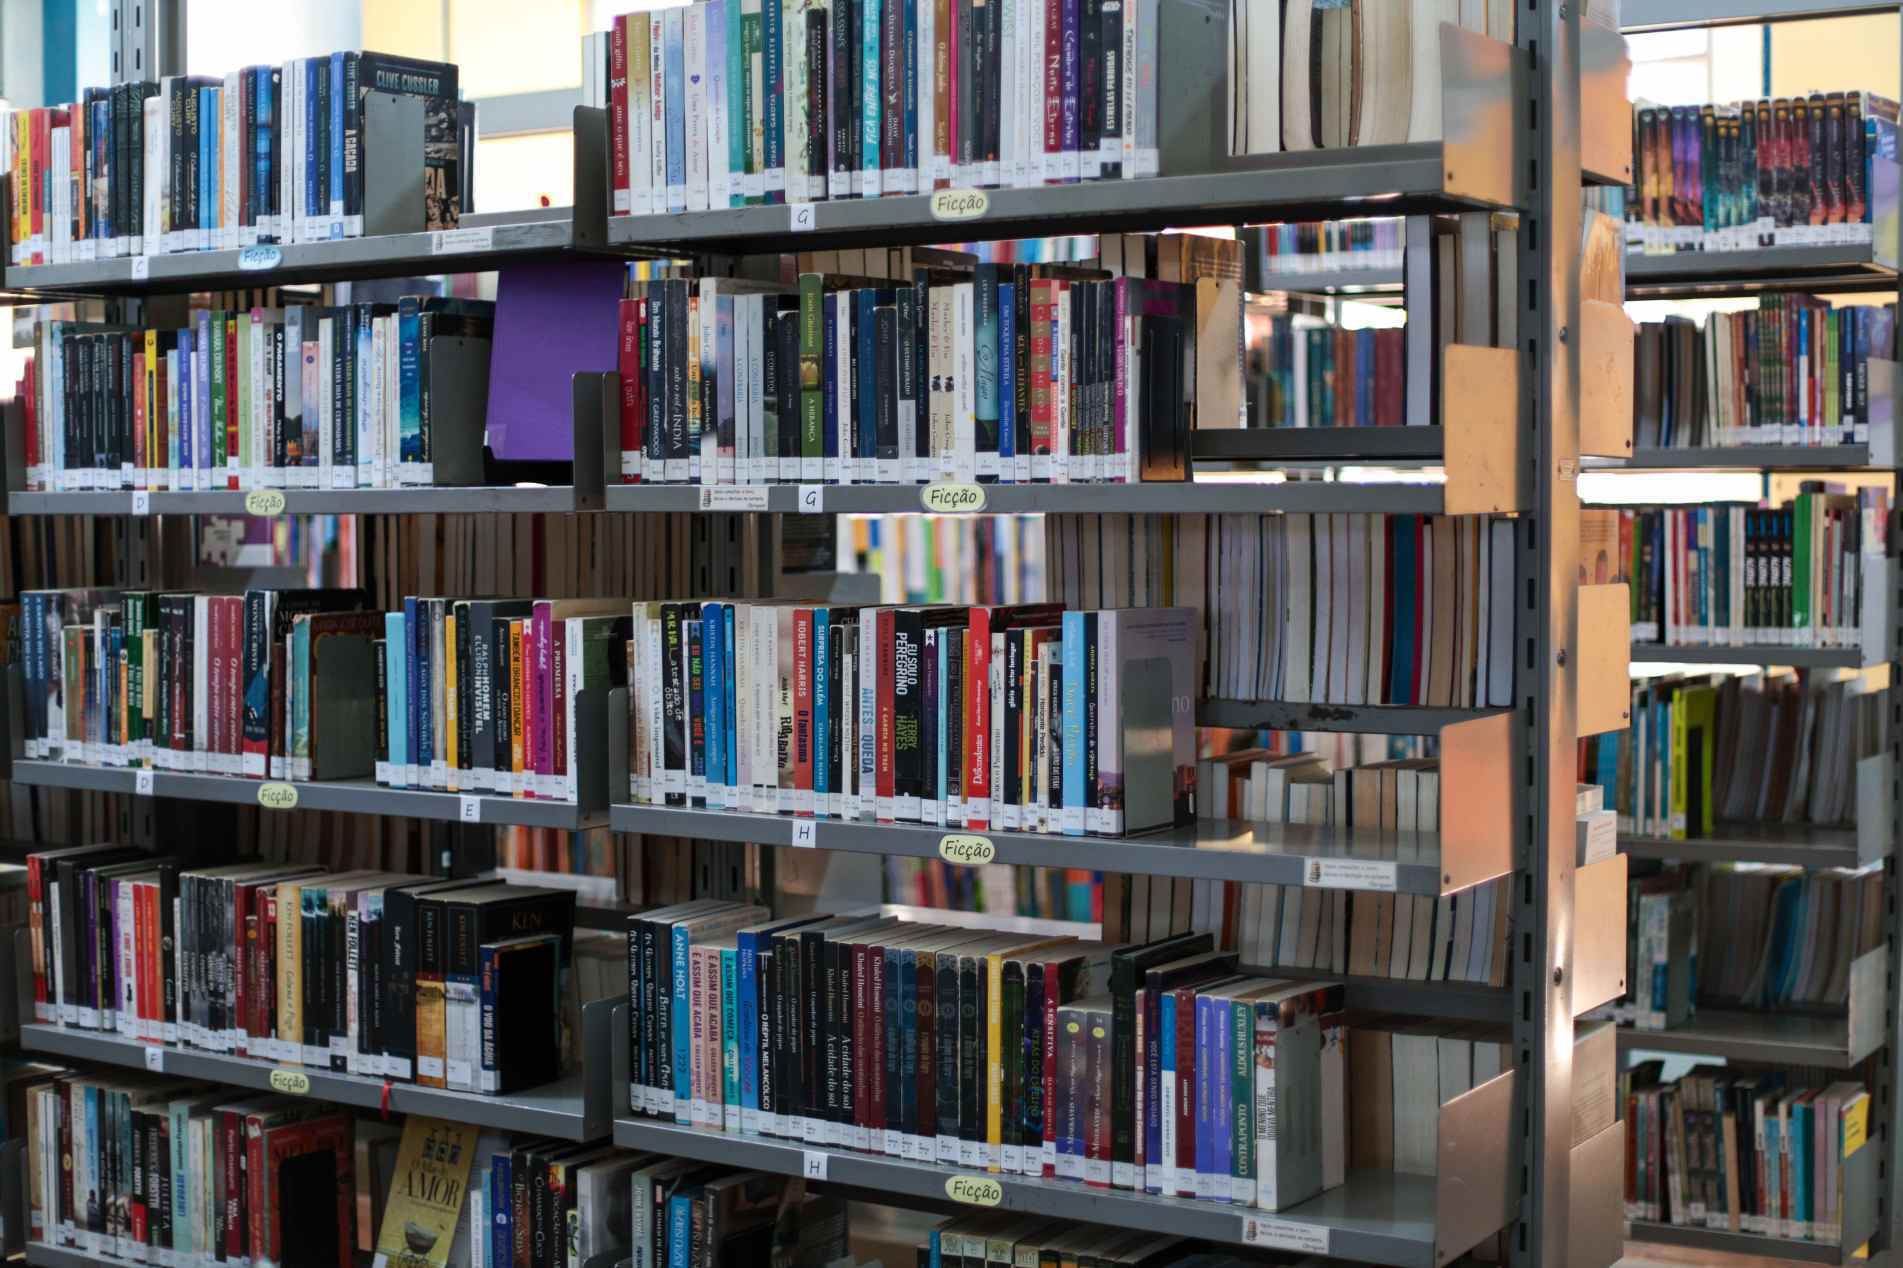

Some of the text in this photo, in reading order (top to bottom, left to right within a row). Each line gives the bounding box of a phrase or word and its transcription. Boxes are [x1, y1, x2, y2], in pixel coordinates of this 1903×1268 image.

[190, 88, 198, 135] AUGUSTO
[343, 137, 357, 173] CAÇADA
[797, 209, 809, 224] G
[936, 193, 985, 214] Ficção
[276, 332, 283, 340] O
[137, 497, 145, 509] D
[249, 493, 283, 514] Ficção
[805, 491, 816, 507] G
[929, 489, 978, 509] Ficção
[797, 620, 807, 697] ROBERT HARRIS
[816, 624, 826, 706] SURPRESA DO ALÉM
[894, 632, 908, 696] PEREGRINO
[907, 643, 919, 685] EU SOU O
[553, 650, 562, 699] PROMESSA
[474, 676, 483, 735] INVISÍVEL
[482, 676, 490, 721] HOMEM
[860, 687, 875, 774] ANTES QUEDA
[895, 715, 918, 751] TERRY HAYES
[261, 786, 295, 805] Ficção
[465, 804, 474, 816] E
[799, 826, 810, 841] H
[944, 839, 991, 861] Ficção
[347, 935, 358, 971] FOLLETT
[675, 933, 686, 1000] ANNE HOLT
[692, 960, 702, 989] ASSIM
[708, 962, 718, 991] ASSIM
[692, 990, 702, 1009] QUE
[708, 993, 718, 1011] QUE
[692, 1009, 702, 1039] ACABA
[708, 1013, 718, 1042] ACABA
[762, 1021, 770, 1050] RÉPTIL
[1237, 1007, 1247, 1078] ALDOUS HUXLEY
[273, 1075, 306, 1091] Ficção
[762, 1051, 771, 1109] MELANCÓLICO
[827, 1034, 837, 1107] A cidade do sol
[842, 1035, 852, 1109] A cidade do sol
[1237, 1104, 1248, 1175] CONTRAPONTO
[809, 1159, 820, 1174] H
[953, 1181, 1000, 1201] Ficção
